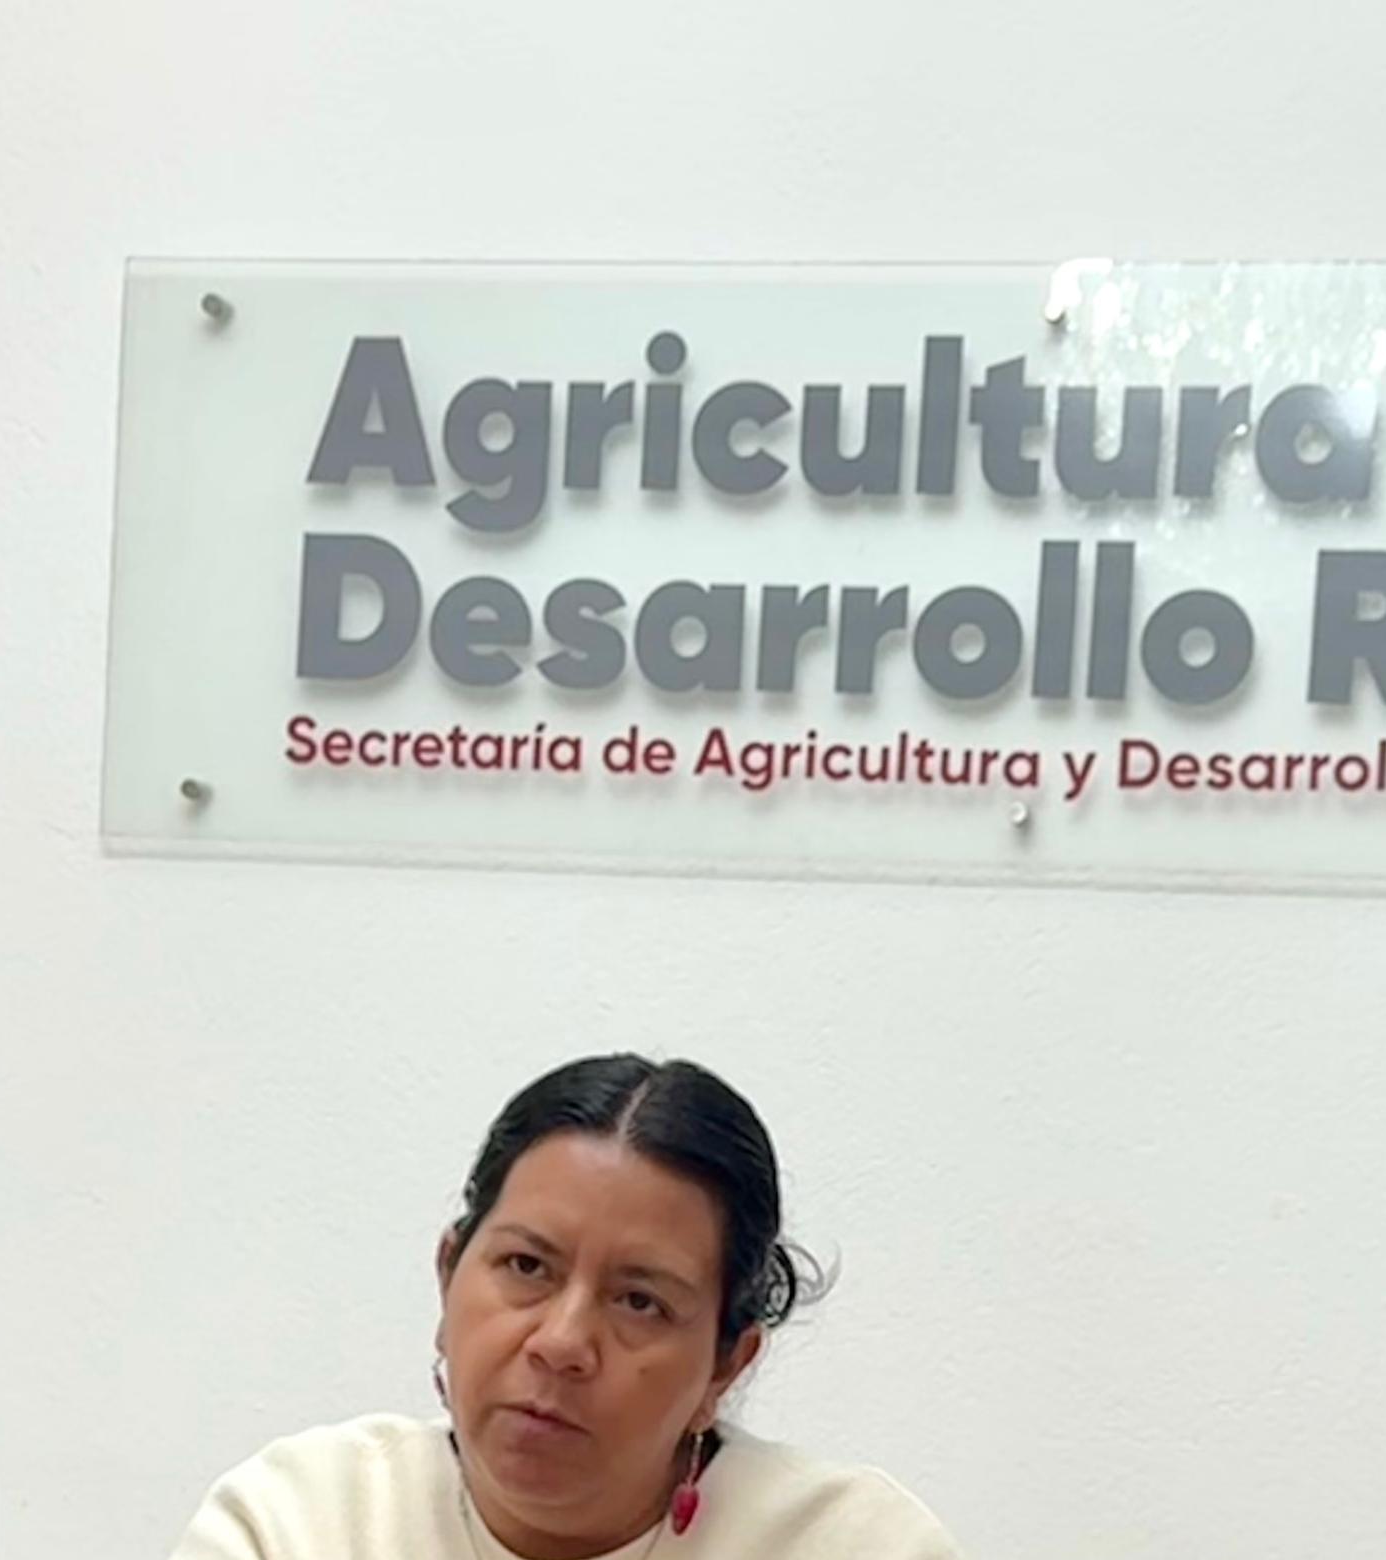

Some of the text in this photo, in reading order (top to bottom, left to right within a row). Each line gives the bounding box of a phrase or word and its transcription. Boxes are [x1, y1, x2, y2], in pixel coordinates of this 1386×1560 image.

[305, 331, 1376, 535] Agricultura
[296, 533, 1254, 706] Desarrollo
[285, 715, 583, 772] Secretaría
[601, 725, 676, 775] de
[693, 728, 1041, 793] Agricultura
[1064, 752, 1095, 799] y
